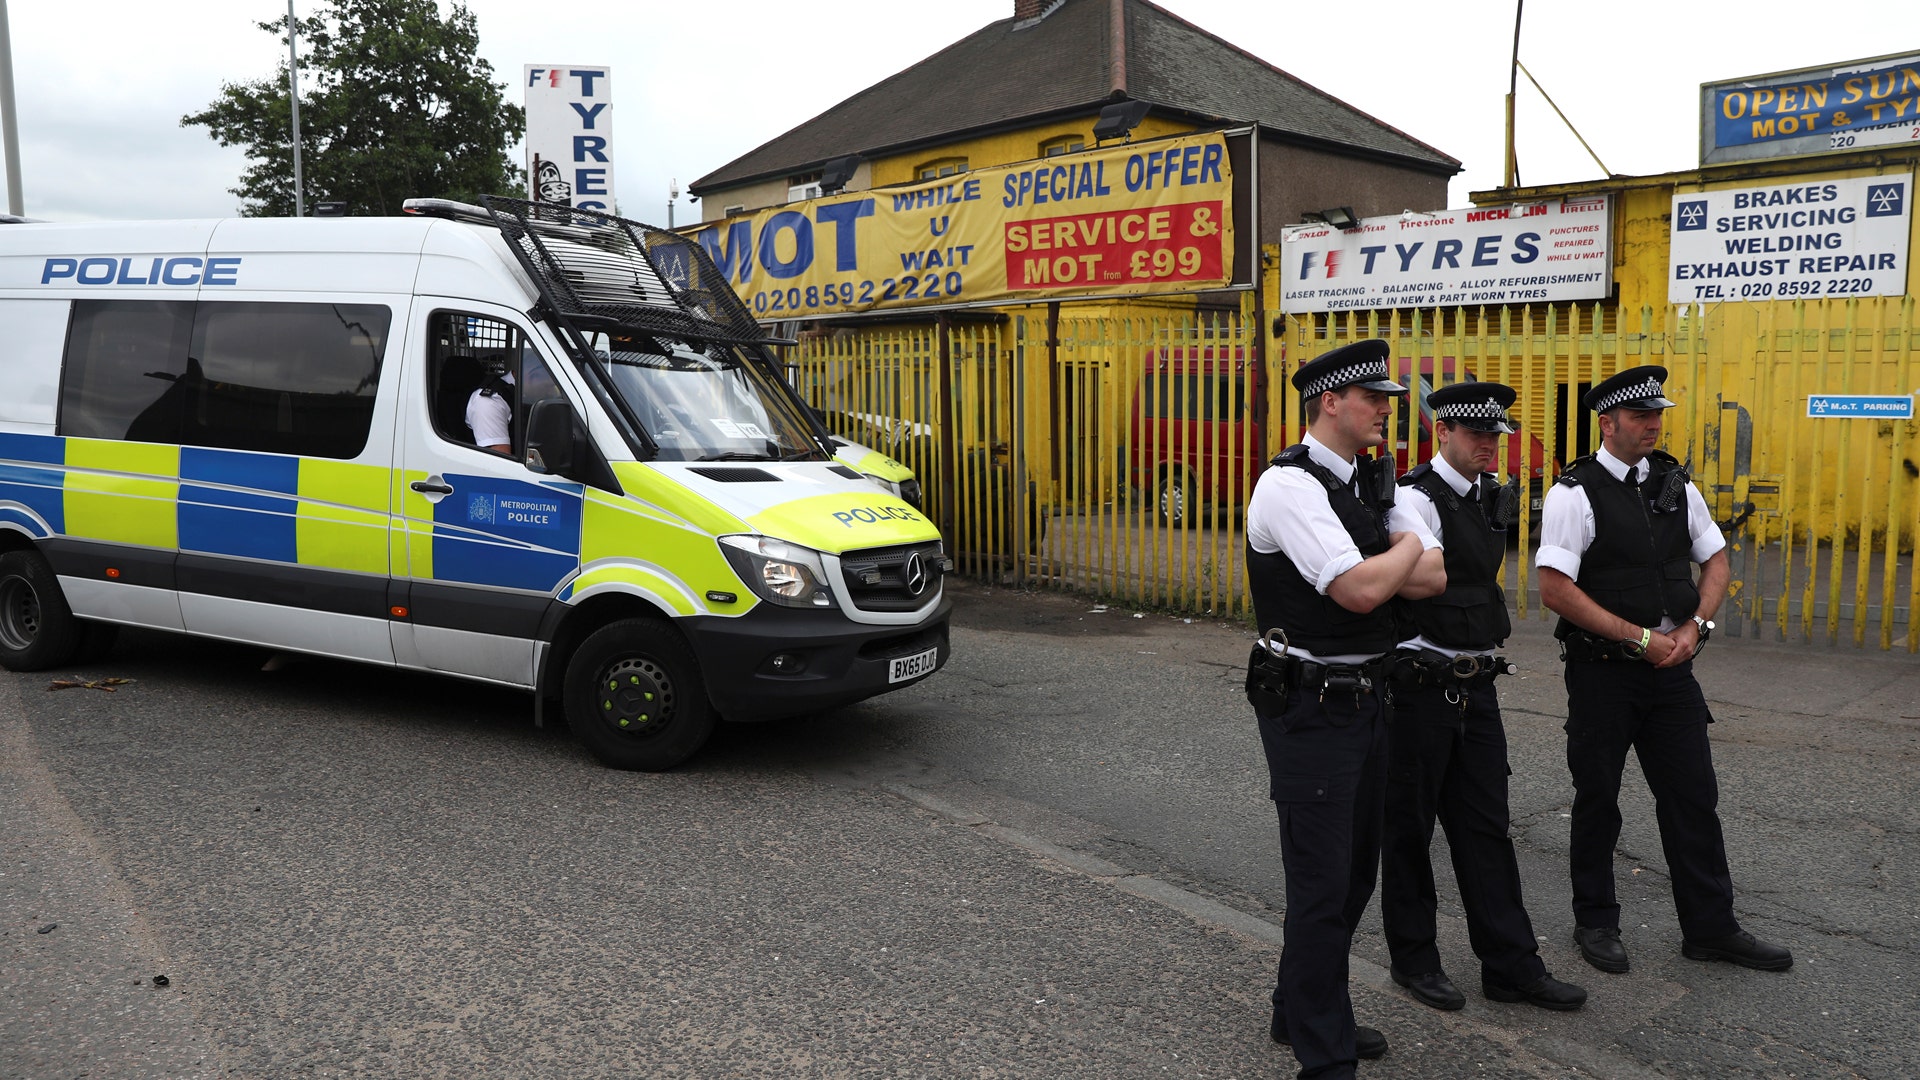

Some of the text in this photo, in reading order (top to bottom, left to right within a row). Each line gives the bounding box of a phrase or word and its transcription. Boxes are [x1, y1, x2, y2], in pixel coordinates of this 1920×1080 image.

[529, 69, 563, 88] F1
[1723, 82, 1828, 120] OPEN
[1752, 96, 1920, 139] MOT & TY
[569, 70, 610, 227] TYRES
[1002, 143, 1223, 209] SPECIAL OFFER
[893, 179, 981, 212] WHILE
[1560, 200, 1605, 214] PIRELLI
[1734, 184, 1838, 210] BRAKES
[1399, 217, 1456, 231] Firestone
[1466, 204, 1548, 223] MICHLIN
[1716, 206, 1856, 233] SERVICING
[930, 216, 949, 237] U
[1007, 207, 1220, 253] SERVICE &
[1298, 231, 1330, 240] UNLOP
[1549, 224, 1600, 236] PUNCTURES
[698, 198, 875, 288] MOT
[1360, 232, 1541, 275] TYRES
[1553, 238, 1594, 248] REPAIRED
[1725, 232, 1842, 255] WELDING
[901, 245, 975, 271] WAIT
[1024, 247, 1202, 285] MOT from £99
[1299, 250, 1345, 280] F1
[1547, 251, 1605, 262] WHILE U WAIT
[1675, 252, 1896, 280] EXHAUST REPAIR
[41, 257, 242, 286] POLICE
[1285, 272, 1602, 299] LASER TRACKING BALANCING ALLOY REFURBISHMENT
[1740, 282, 1773, 297] 020
[1777, 280, 1821, 296] 8592
[1827, 277, 1873, 294] 2220
[1327, 288, 1547, 309] SPECIALISE IN NEW & PART WORN TYRES
[1863, 403, 1908, 411] PARKING
[500, 500, 557, 512] METROPOLITAN
[832, 506, 921, 528] POLICE
[507, 512, 549, 524] POLICE
[894, 657, 920, 679] BX65
